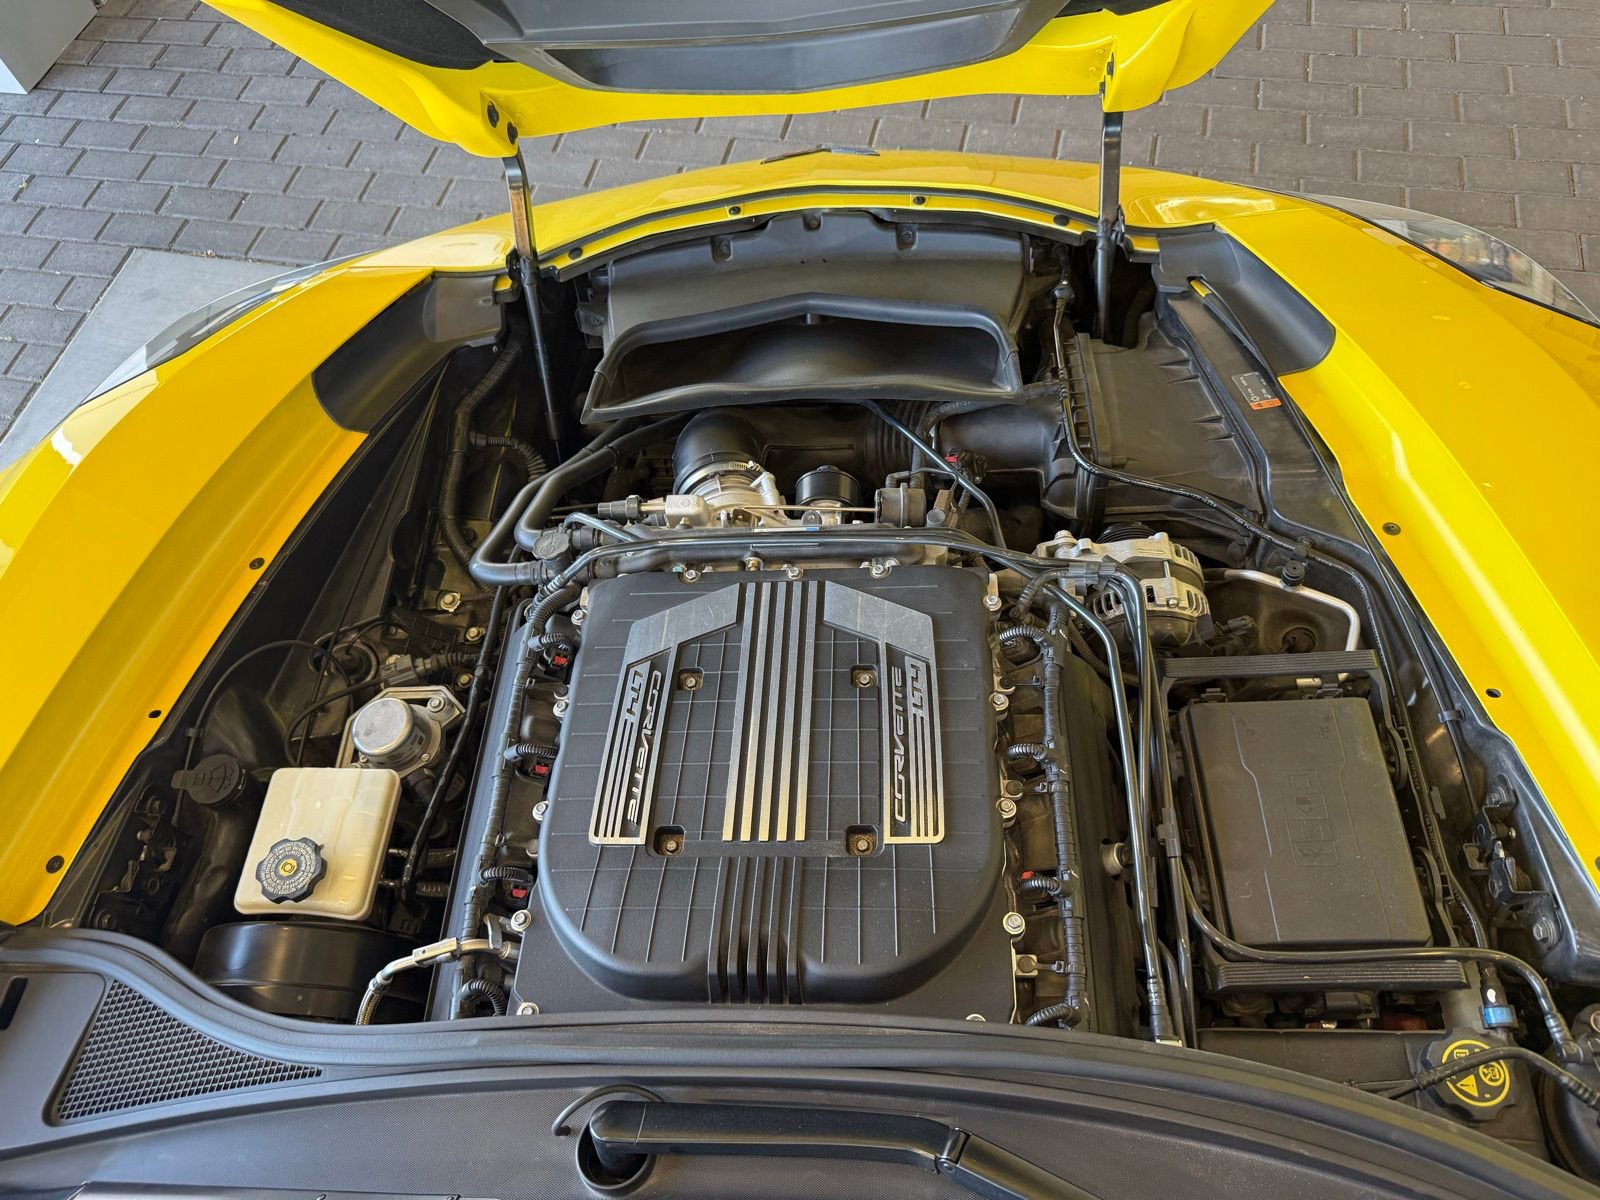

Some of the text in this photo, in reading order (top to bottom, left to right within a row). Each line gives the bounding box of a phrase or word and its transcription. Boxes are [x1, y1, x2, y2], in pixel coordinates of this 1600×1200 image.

[626, 669, 643, 718] LT4
[910, 663, 925, 711] LT4
[627, 669, 662, 824] CORVETTE
[891, 666, 906, 823] CORVETTE
